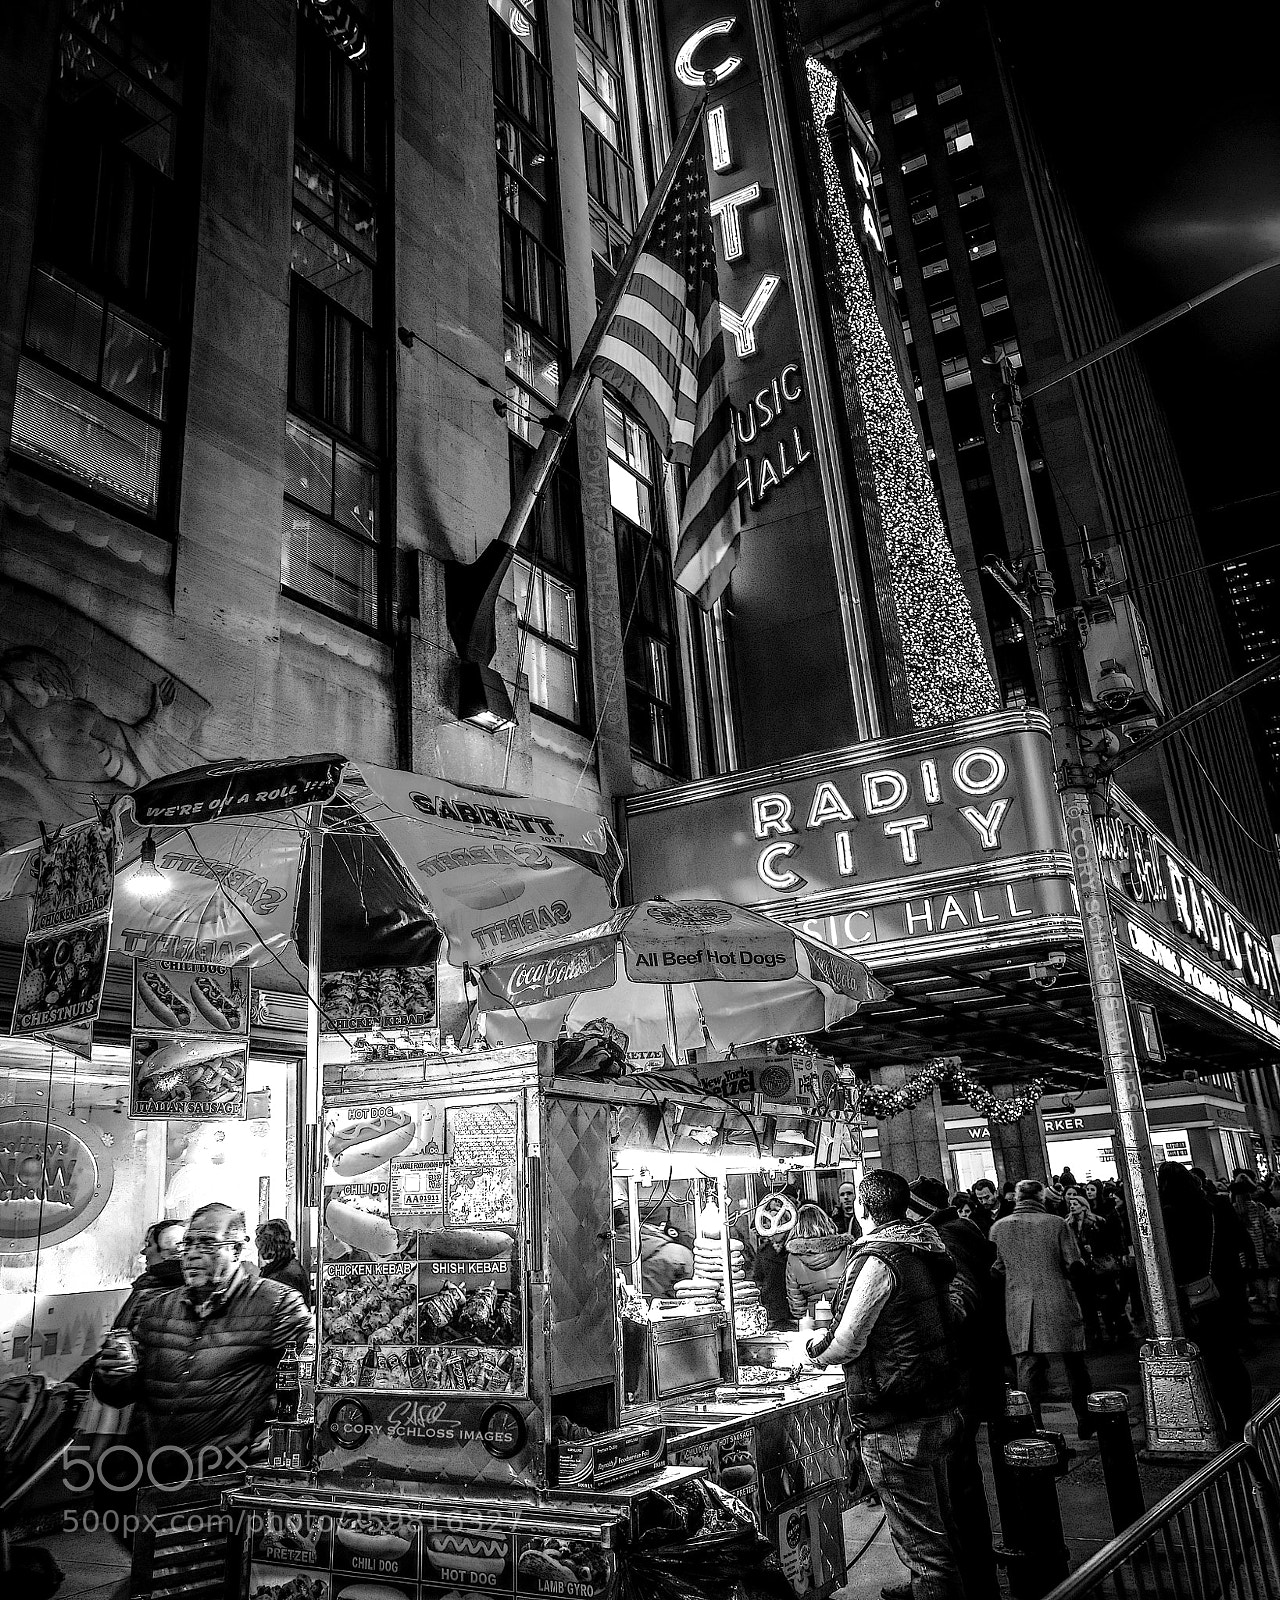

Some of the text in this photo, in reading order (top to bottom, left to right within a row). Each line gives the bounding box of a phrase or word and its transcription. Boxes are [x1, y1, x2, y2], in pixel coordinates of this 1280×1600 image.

[675, 15, 780, 360] CITY
[732, 364, 802, 444] USIC
[146, 802, 204, 817] WE'RE
[208, 796, 233, 810] ON
[237, 793, 250, 804] A
[254, 784, 298, 802] ROLL
[752, 745, 1007, 842] RADIO
[409, 791, 557, 836] SABRETT
[756, 798, 1011, 892] CITY
[40, 905, 76, 929] CHICKEN
[803, 884, 1032, 947] SIC HALL
[160, 961, 227, 975] CHILI DOG
[635, 951, 787, 967] All Beef Hot Dogs
[21, 999, 94, 1028] CHESTNUTS
[382, 1014, 426, 1026] KEBAB
[701, 1076, 721, 1090] New
[135, 1101, 243, 1114] ITALIAN SAUSAGE
[348, 1106, 393, 1120] HOT DOG
[344, 1182, 388, 1196] CHILI DO
[328, 1263, 411, 1276] CHICKEN KEBAB
[432, 1261, 508, 1274] SHISH KEBAB
[266, 1546, 317, 1564] PRETZEL
[352, 1556, 399, 1573] CHILI DOG
[441, 1567, 497, 1586] HOT DOG
[538, 1578, 594, 1597] LAMB GYRO
